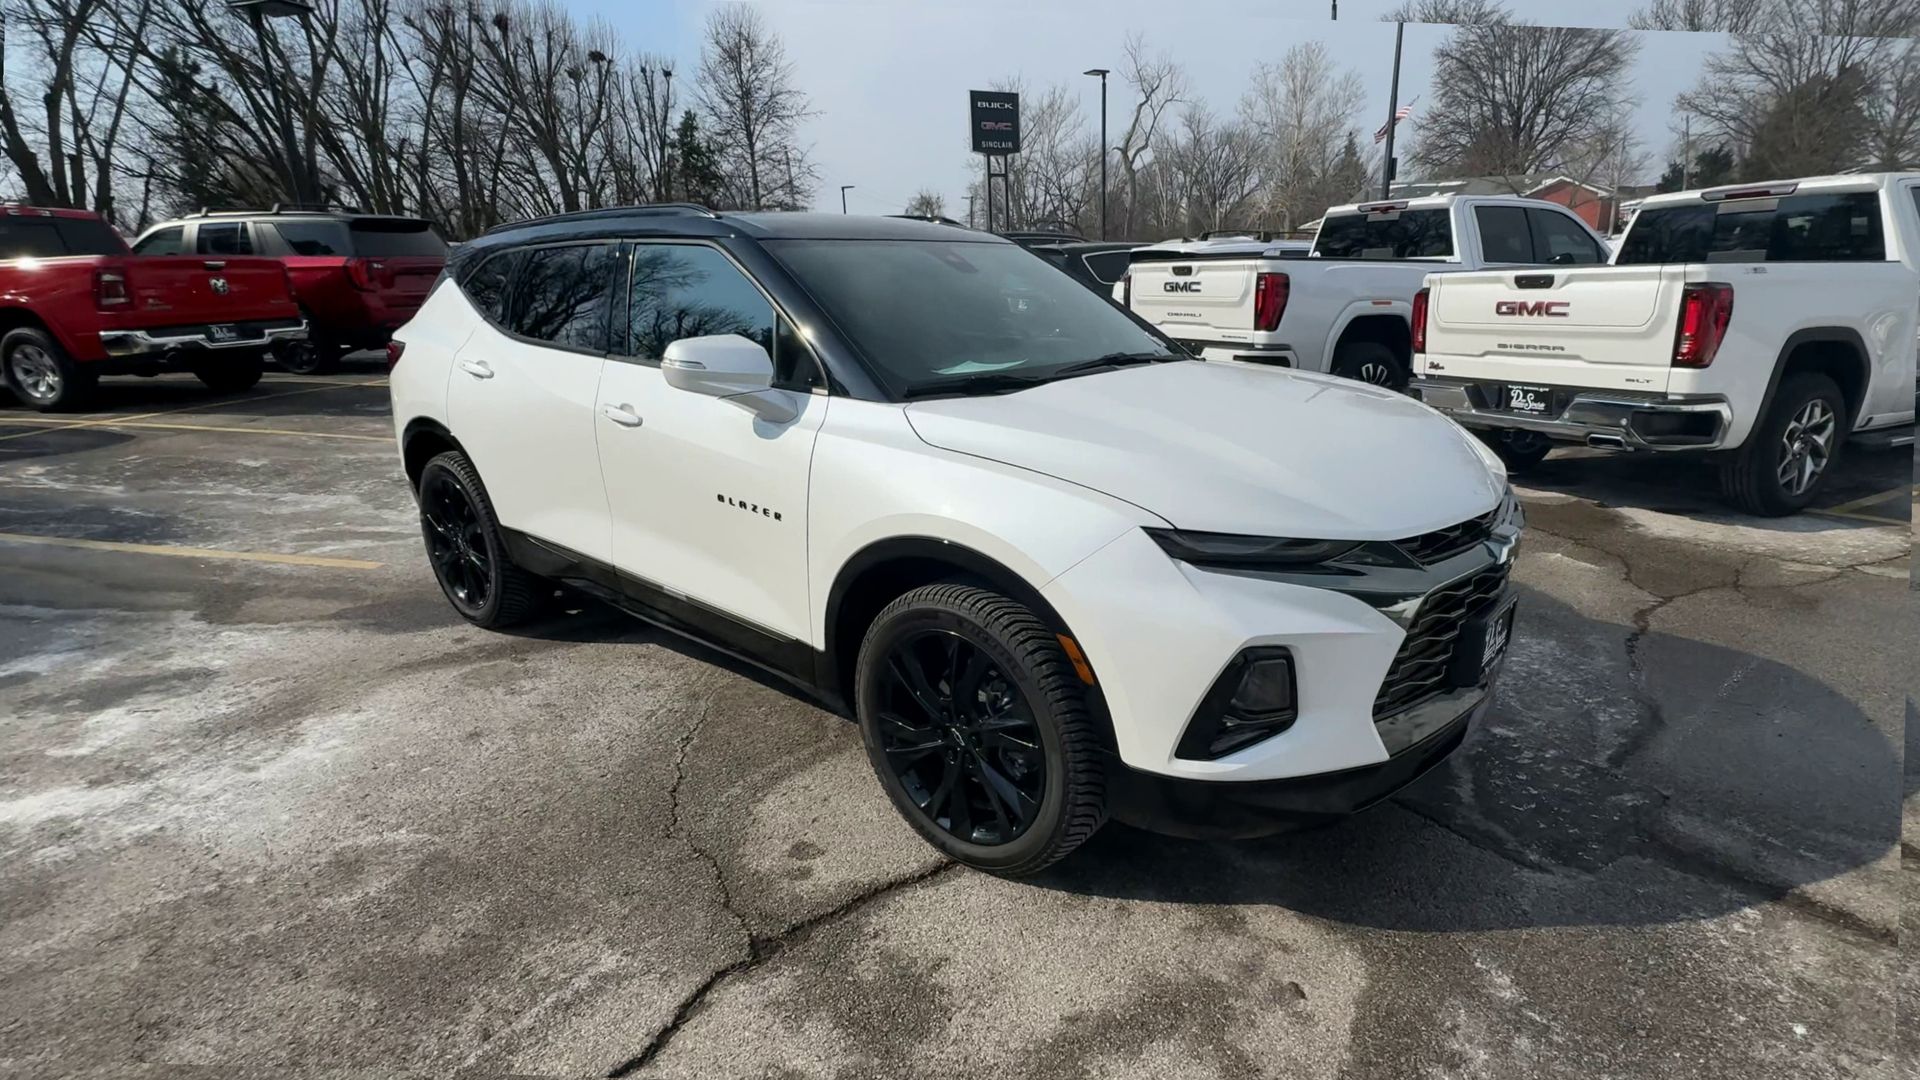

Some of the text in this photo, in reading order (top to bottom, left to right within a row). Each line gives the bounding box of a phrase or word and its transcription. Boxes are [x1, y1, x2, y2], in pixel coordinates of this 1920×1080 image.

[977, 101, 1014, 110] BUICK
[981, 121, 1013, 131] GMC
[981, 140, 1013, 149] SINCLAIR
[1163, 281, 1202, 293] GMC
[1495, 301, 1570, 318] GMC
[1497, 343, 1566, 352] SIERRA
[717, 493, 782, 521] BLAZER
